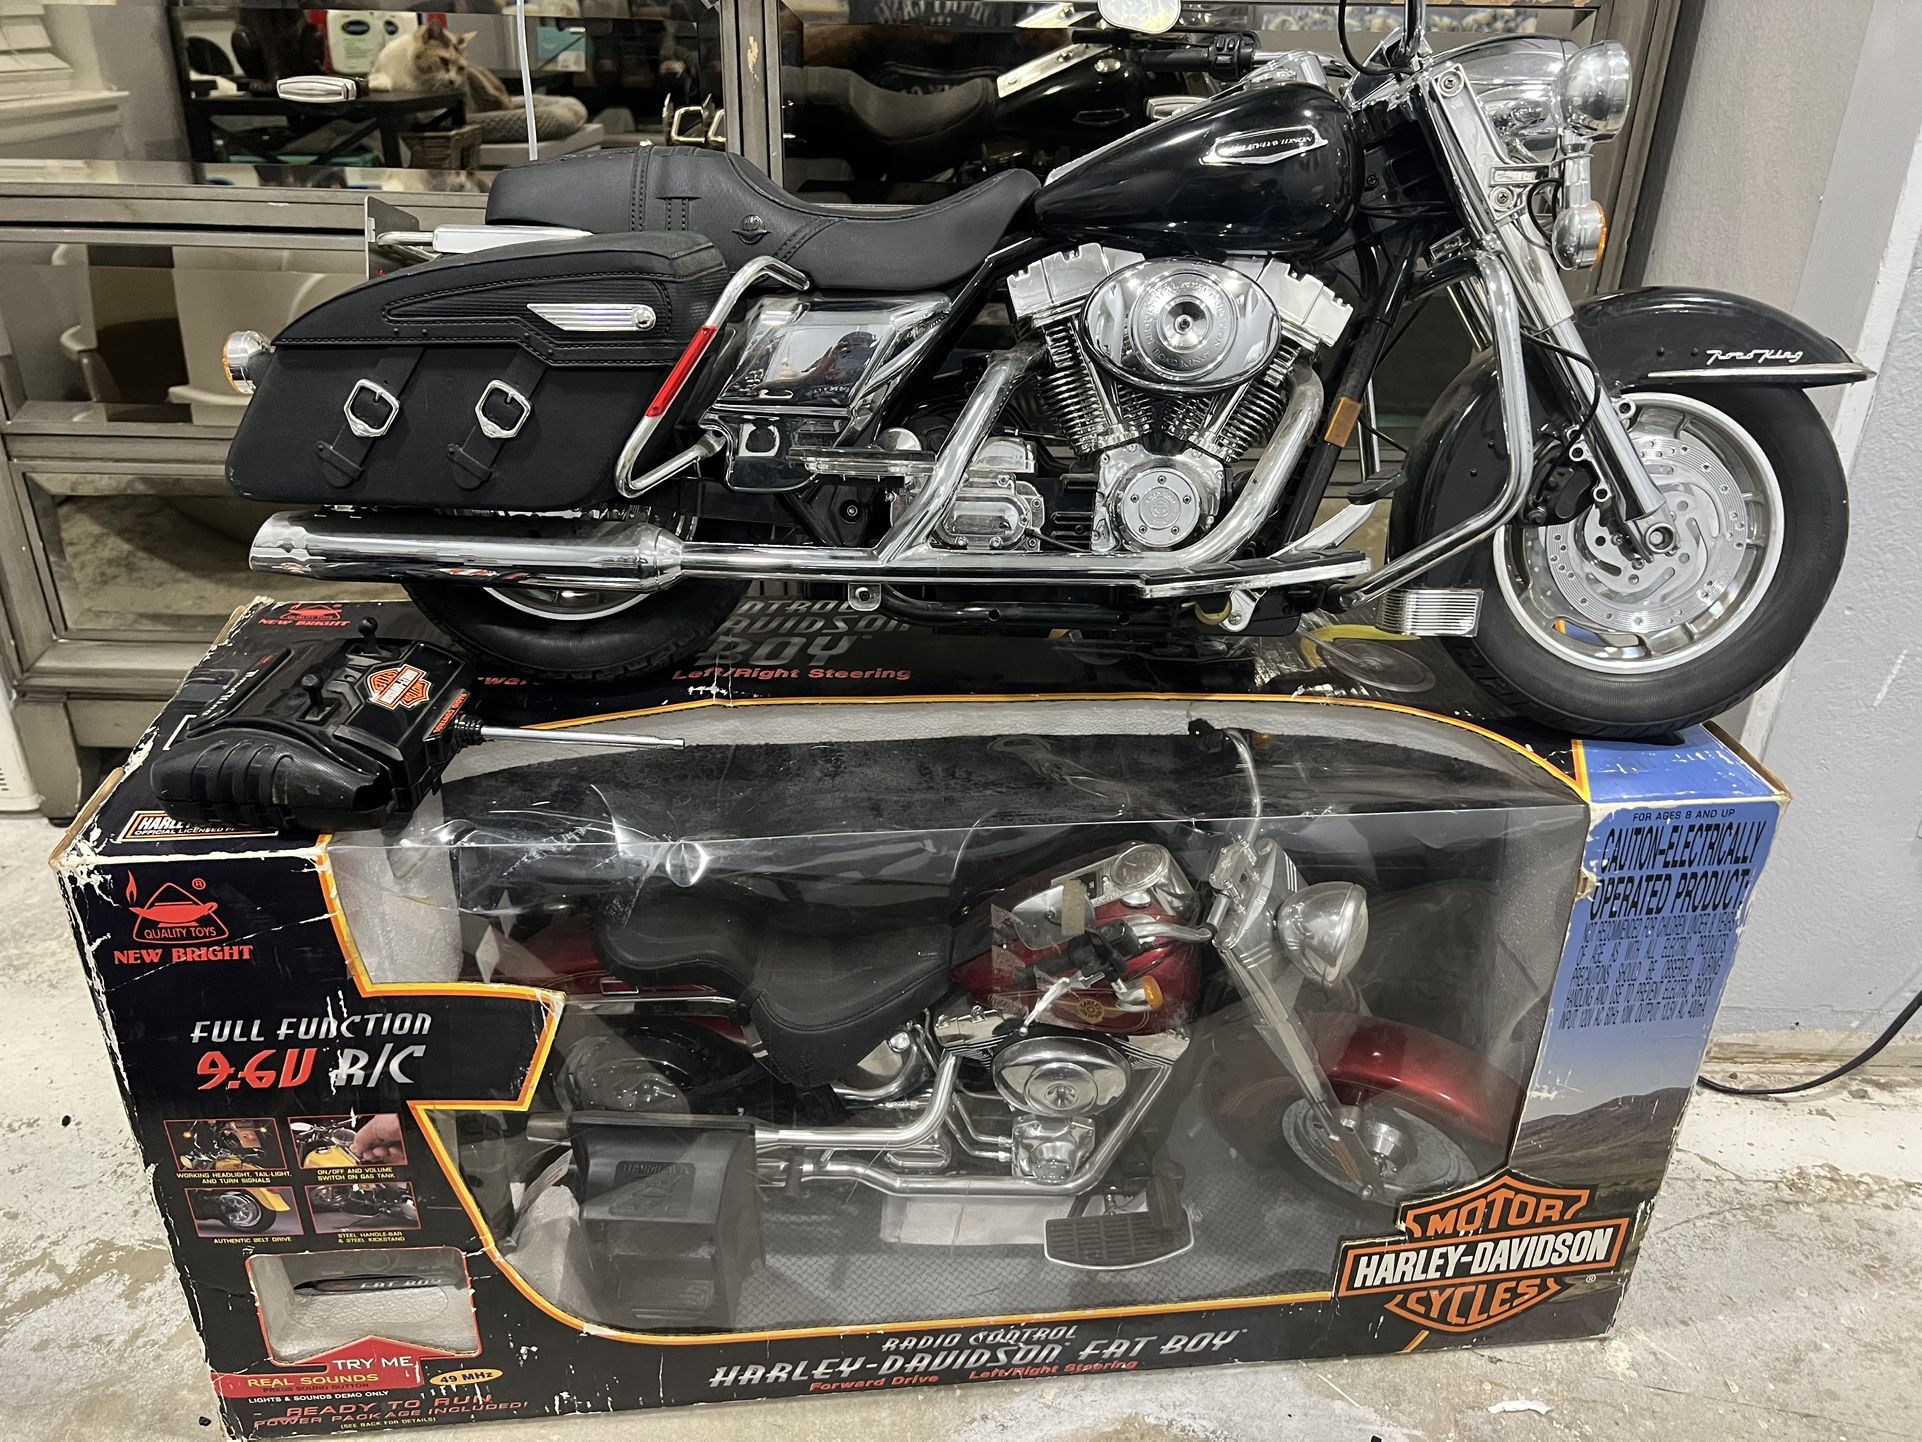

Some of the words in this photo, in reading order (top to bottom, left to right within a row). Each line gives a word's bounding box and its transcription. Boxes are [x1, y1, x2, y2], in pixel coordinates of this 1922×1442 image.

[693, 634, 858, 666] BOY
[672, 667, 800, 681] Left/Right
[807, 667, 912, 681] Steering
[1633, 813, 1652, 822] FOR
[1656, 811, 1681, 820] AGES
[1695, 809, 1717, 819] AND
[1721, 808, 1736, 818] UP
[1601, 821, 1767, 874] CAUTION-ELECTRICALLY
[1590, 873, 1674, 921] OPERATED
[144, 927, 187, 939] QUALITY
[189, 926, 217, 937] TOYS
[113, 948, 163, 965] NEW
[171, 945, 254, 962] BRIGHT
[190, 1019, 265, 1043] FULL
[276, 1012, 432, 1040] FUNCTION
[334, 1042, 427, 1088] R/C
[1426, 1187, 1564, 1237] MOTOR
[1353, 1227, 1614, 1289] HARLEY-DAVIDSON
[1406, 1277, 1541, 1325] CYCLES
[881, 1333, 962, 1352] RADIO
[968, 1324, 1078, 1345] CONTROL
[332, 1358, 376, 1371] TRY
[381, 1356, 414, 1368] ME
[709, 1343, 1064, 1388] HARLEY-DAVIDSON
[1077, 1336, 1158, 1361] FAT
[1160, 1330, 1240, 1355] BOY
[462, 1371, 494, 1381] MHz
[968, 1363, 1058, 1380] Left/Right
[1064, 1360, 1139, 1373] Steering
[247, 1376, 295, 1388] REAL
[300, 1373, 380, 1385] SOUNDS
[331, 1382, 369, 1390] BUTTON
[809, 1377, 886, 1392] Forward
[891, 1374, 941, 1386] Drive
[248, 1396, 282, 1404] LIGHTS
[365, 1390, 389, 1398] ONLY
[253, 1416, 322, 1429] POWER
[428, 1401, 528, 1415] INCLUDED!
[286, 1402, 378, 1417] READY
[387, 1399, 422, 1410] TO
[402, 1416, 436, 1425] DETAILS)
